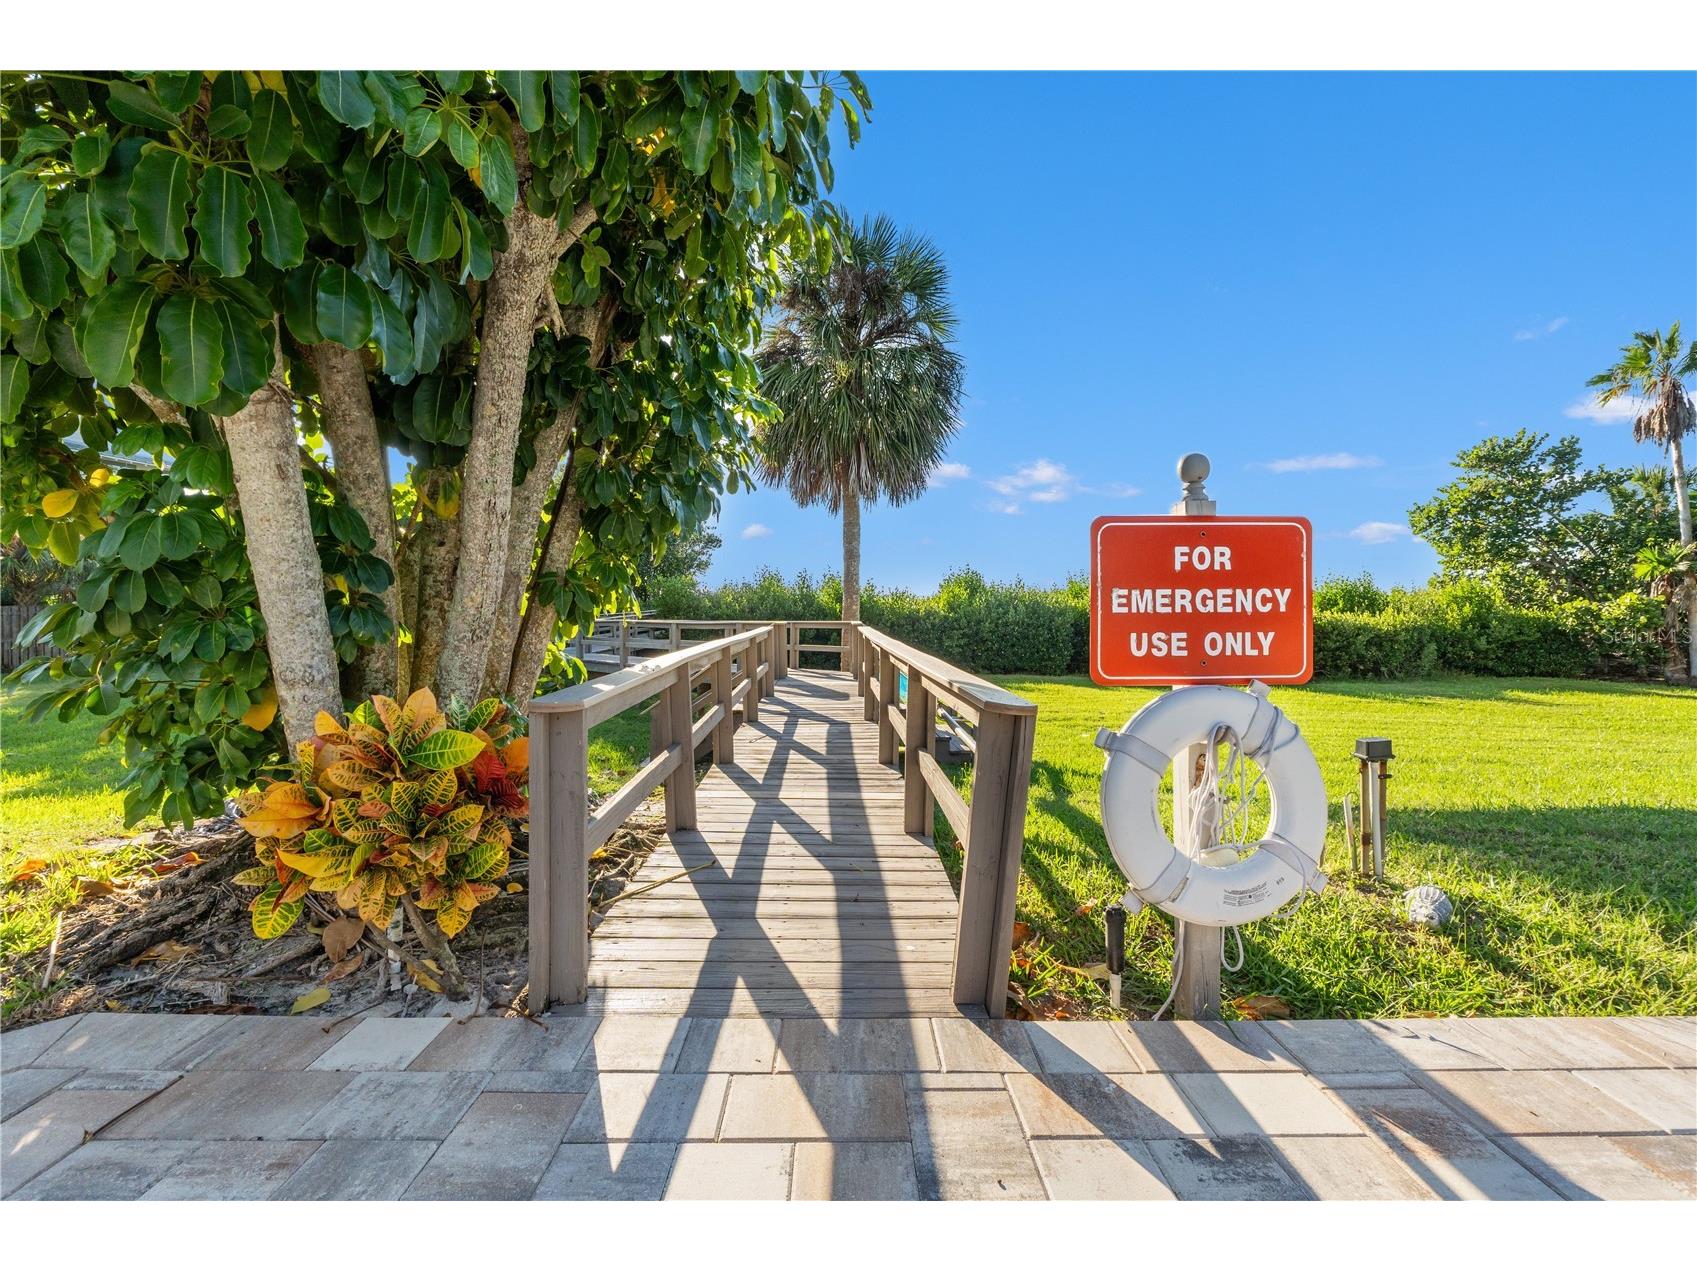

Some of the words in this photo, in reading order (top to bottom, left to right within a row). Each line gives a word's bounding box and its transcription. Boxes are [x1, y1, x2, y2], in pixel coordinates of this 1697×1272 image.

[1174, 546, 1232, 571] FOR
[1111, 587, 1292, 615] EMERGENCY
[1130, 632, 1188, 657] USE
[1204, 631, 1276, 657] ONLY
